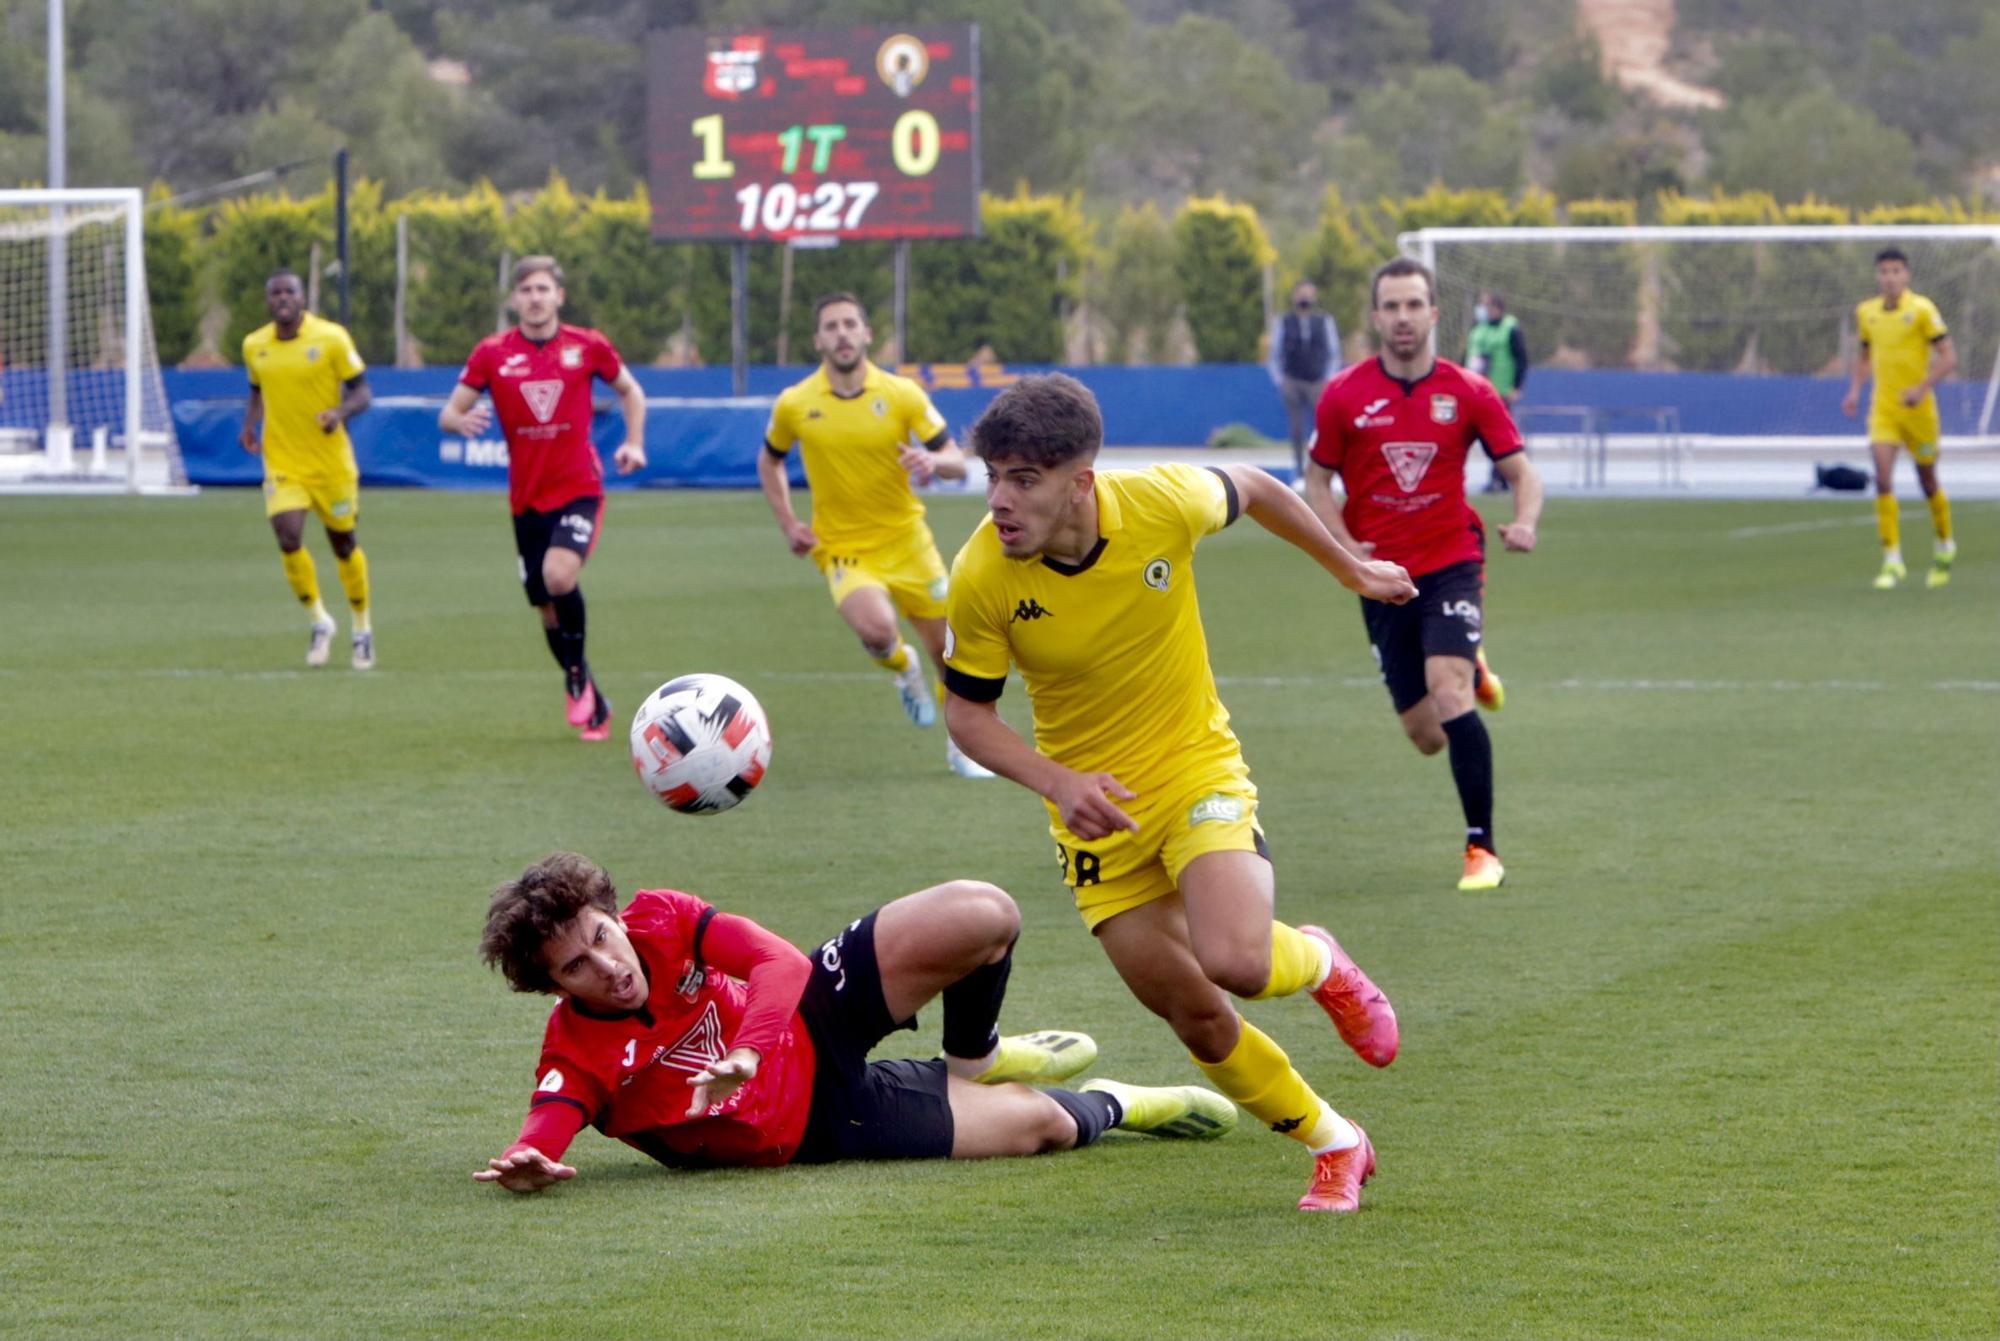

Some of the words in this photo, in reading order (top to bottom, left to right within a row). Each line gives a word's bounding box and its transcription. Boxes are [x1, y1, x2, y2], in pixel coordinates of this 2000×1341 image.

[692, 114, 735, 179] 1
[778, 125, 846, 173] 1T
[892, 110, 940, 176] 0
[736, 181, 879, 231] 10:27
